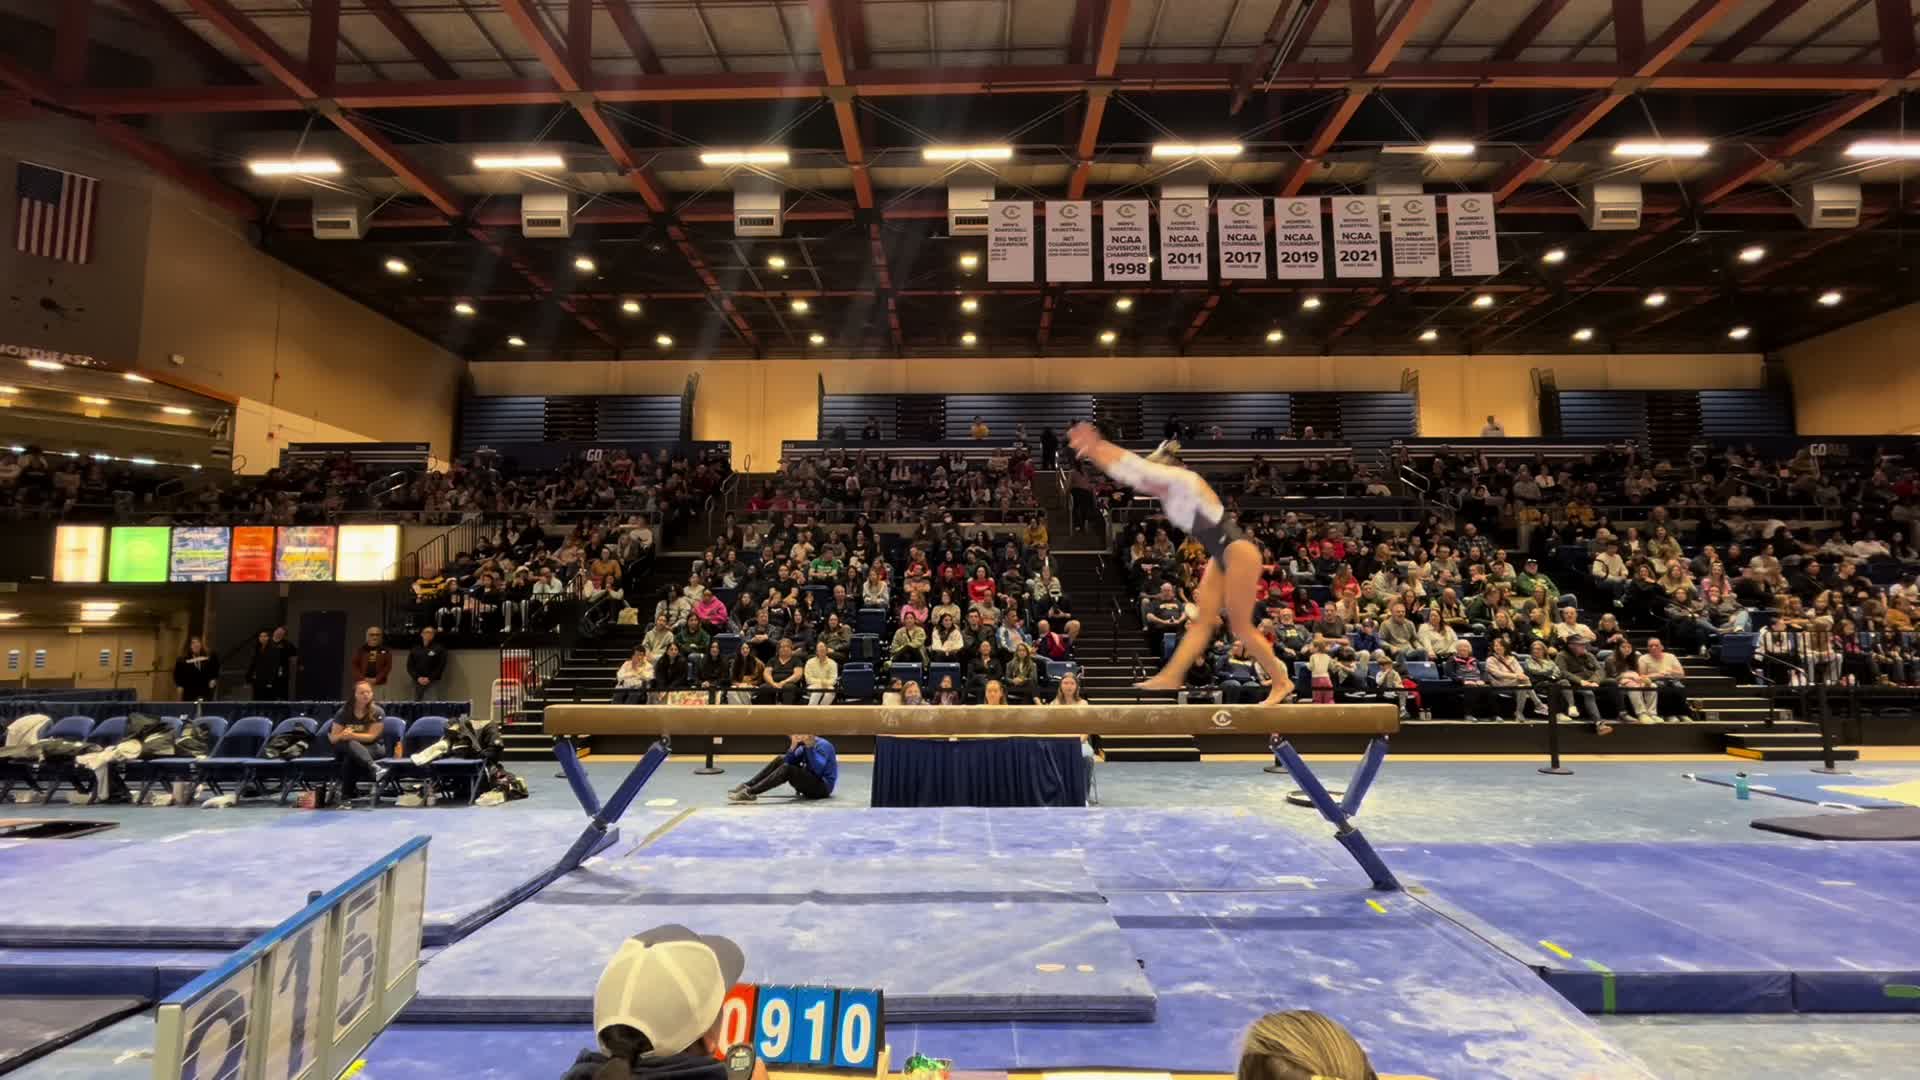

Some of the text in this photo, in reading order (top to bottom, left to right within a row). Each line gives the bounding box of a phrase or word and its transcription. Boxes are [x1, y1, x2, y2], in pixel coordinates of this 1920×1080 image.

[1111, 235, 1142, 244] NCAA
[1169, 235, 1198, 243] NCAA
[1227, 233, 1257, 241] NCAA
[1284, 233, 1314, 241] NCAA
[1342, 232, 1372, 240] NCAA
[1167, 253, 1201, 264] 2011
[1224, 251, 1261, 263] 2017
[1281, 251, 1319, 263] 2019
[1339, 250, 1377, 262] 2021
[1108, 263, 1147, 275] 1998
[586, 449, 602, 462] GO
[1810, 443, 1826, 457] GO
